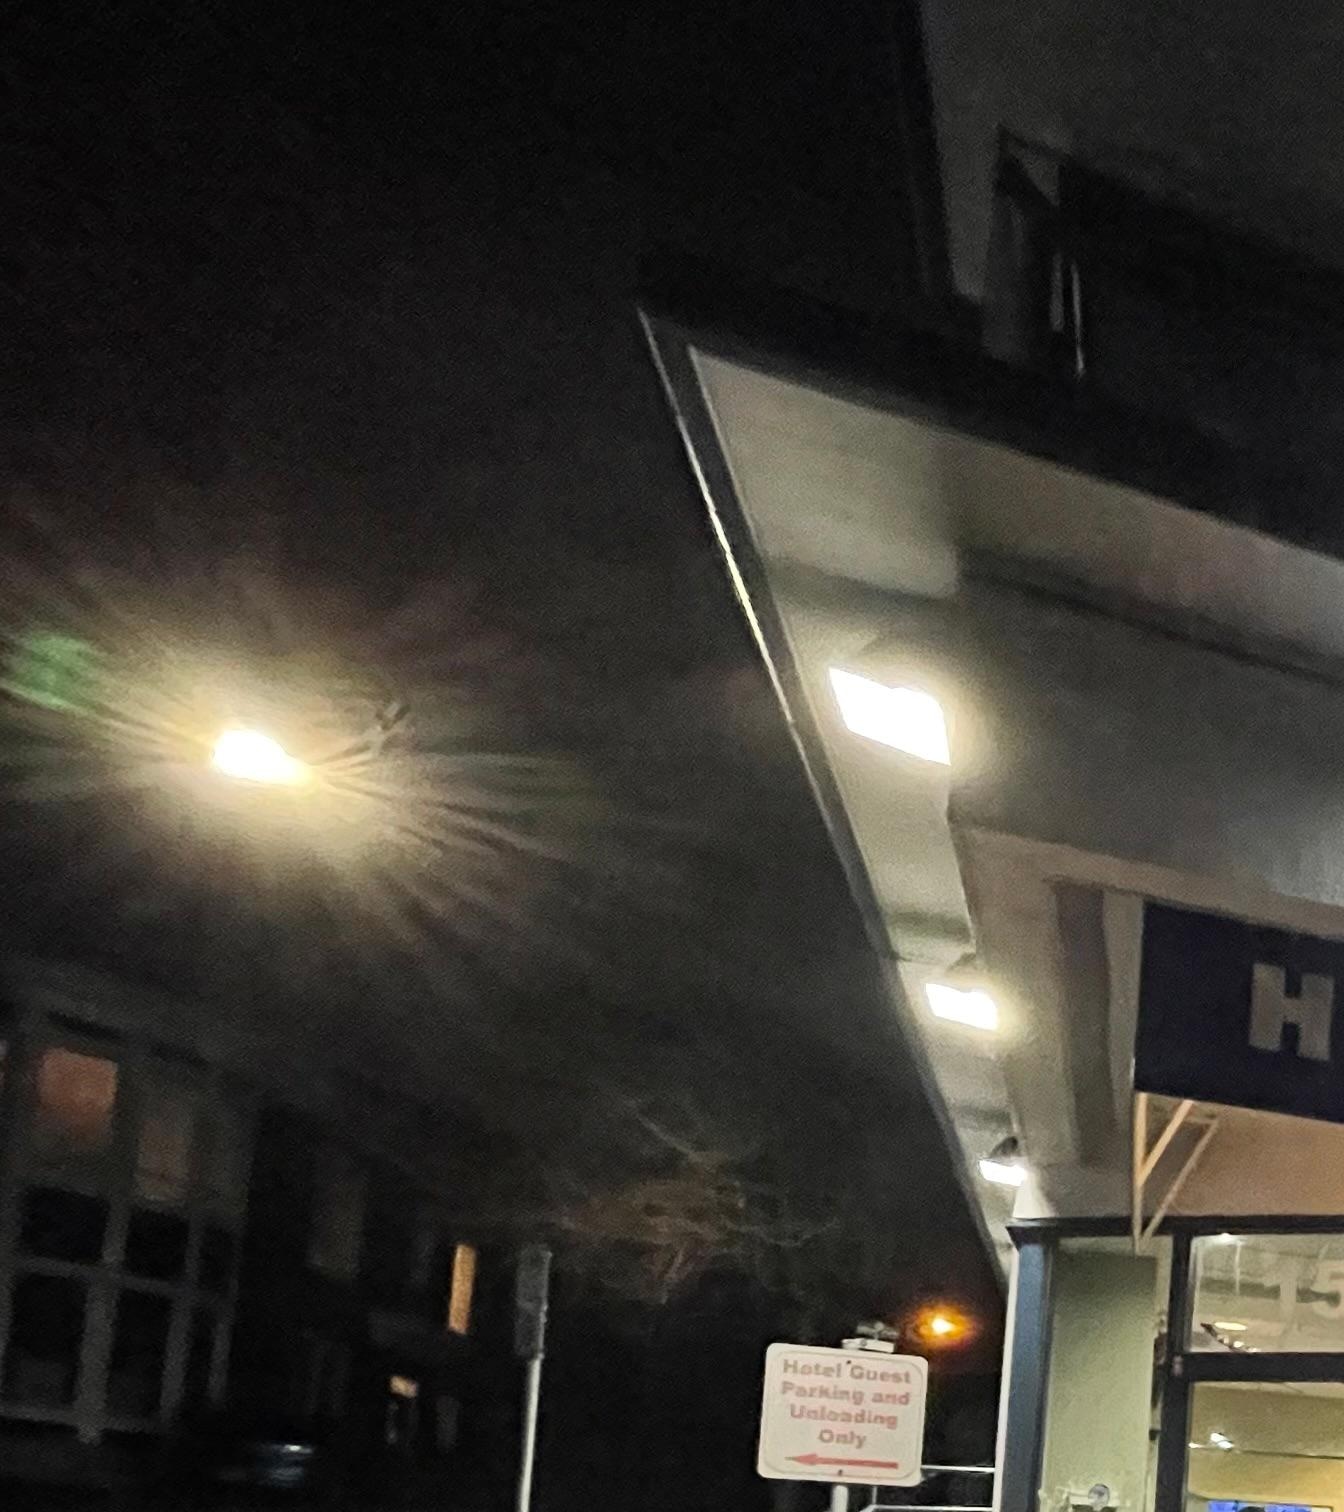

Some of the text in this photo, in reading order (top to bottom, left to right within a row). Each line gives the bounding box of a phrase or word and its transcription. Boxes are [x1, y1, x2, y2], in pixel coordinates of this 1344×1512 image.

[782, 1359, 912, 1385] Hotel Guest
[780, 1380, 911, 1406] Parking and
[789, 1404, 898, 1429] Unloading
[817, 1428, 867, 1449] Only
